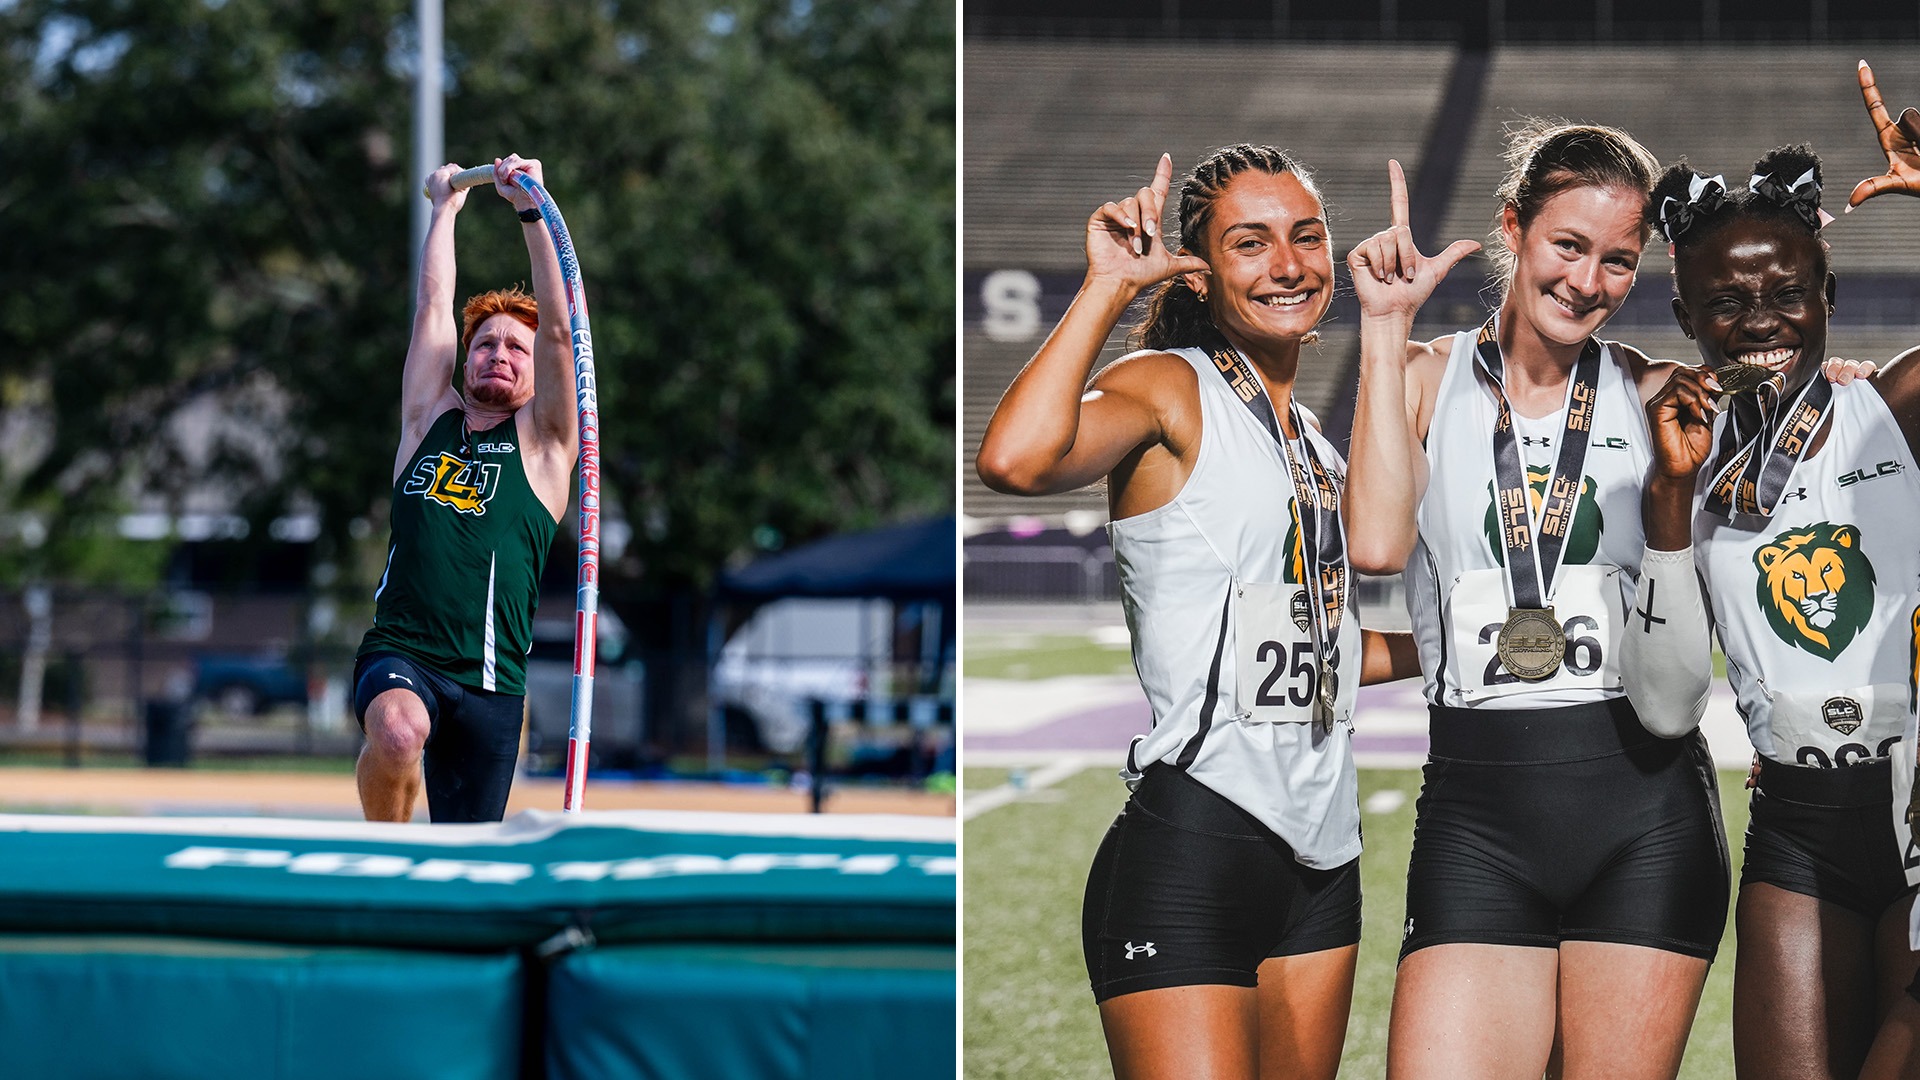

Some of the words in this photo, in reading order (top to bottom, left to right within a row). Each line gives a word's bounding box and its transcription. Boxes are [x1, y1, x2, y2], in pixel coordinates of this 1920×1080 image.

[982, 268, 1041, 342] S
[572, 328, 597, 409] PACER
[1213, 350, 1258, 403] SLC
[1226, 347, 1262, 393] SOUTHLAND
[1568, 380, 1590, 431] SLC
[1583, 388, 1596, 432] SOUTHLAND
[1777, 401, 1807, 449] SOUTHLAND
[1784, 404, 1820, 457] SLC
[478, 442, 515, 453] SLC
[1592, 437, 1631, 450] LC
[578, 410, 600, 587] COMPOSITE
[1713, 450, 1751, 494] OUTHLAND
[1839, 460, 1905, 488] SLC
[1500, 489, 1514, 548] SOUTHLAND
[1507, 487, 1531, 552] SLC
[1542, 474, 1571, 537] SLC
[1557, 481, 1578, 538] SOUTHLAND
[1321, 564, 1339, 630] SLC
[1477, 615, 1603, 687] 26
